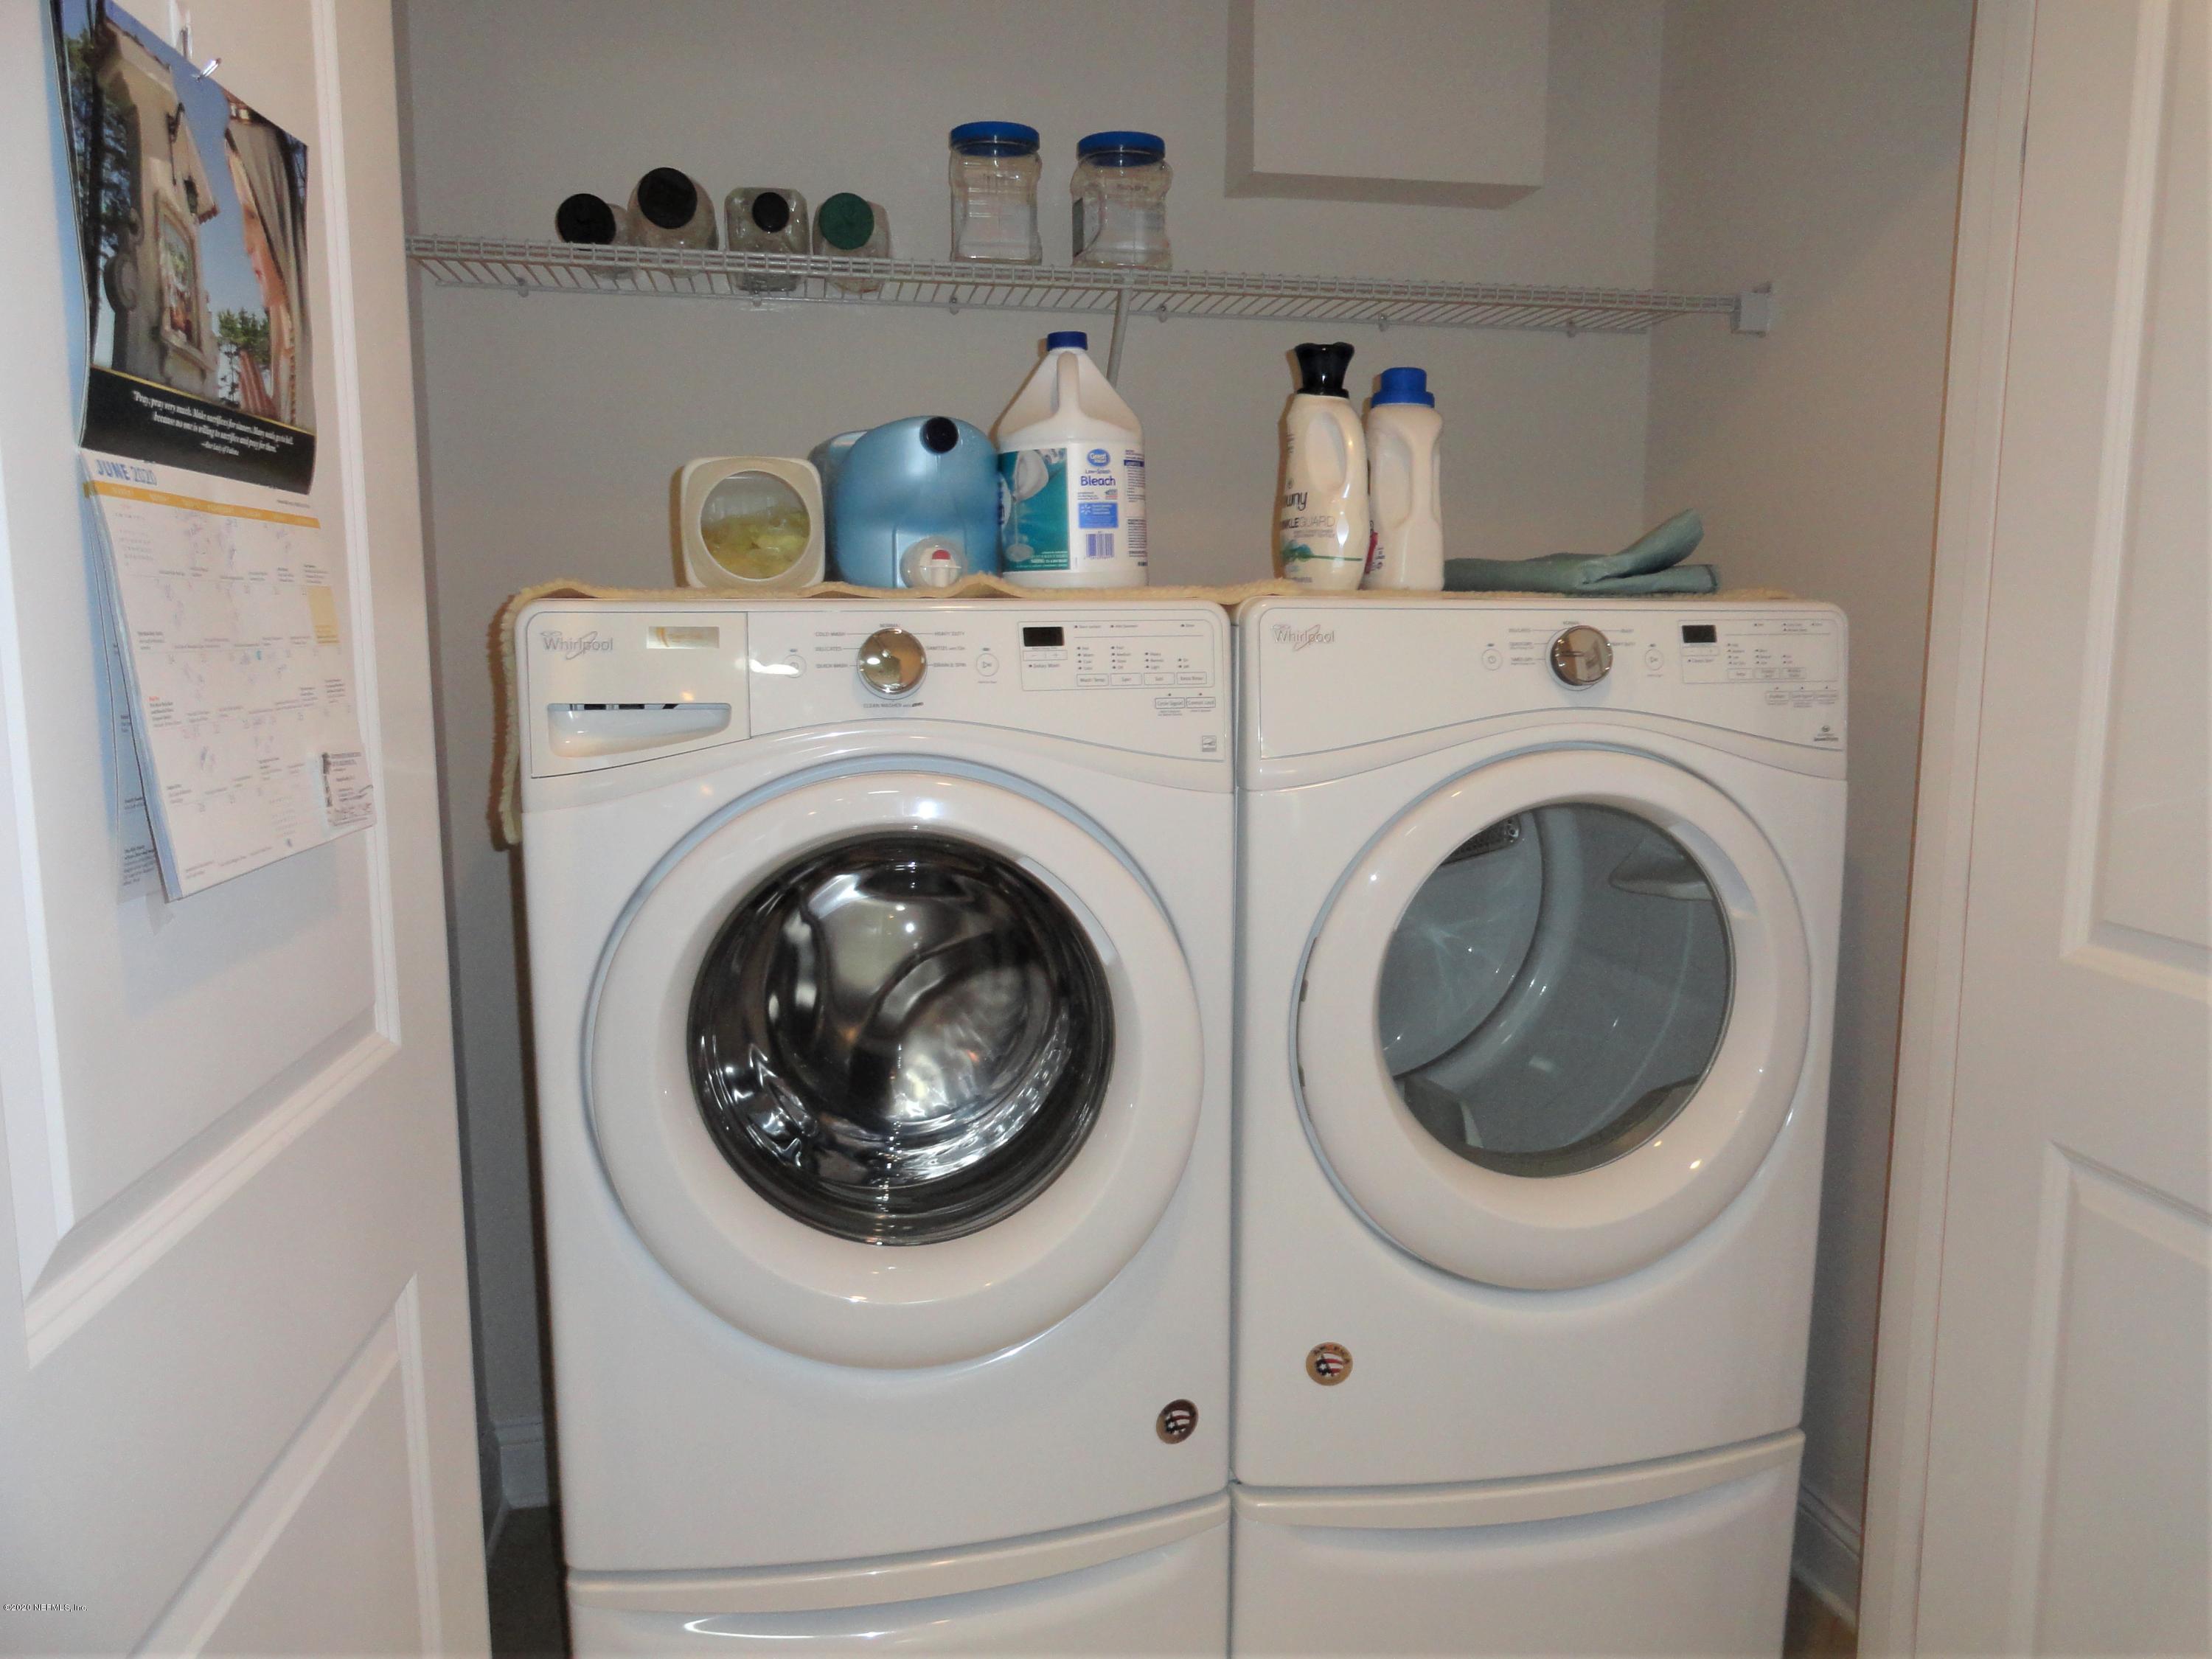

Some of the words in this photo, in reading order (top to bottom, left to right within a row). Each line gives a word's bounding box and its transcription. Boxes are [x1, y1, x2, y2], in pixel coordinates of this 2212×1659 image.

[94, 459, 131, 481] JUNE
[131, 465, 158, 486] 2020
[1080, 475, 1116, 487] Bleach
[541, 631, 613, 660] Whirlpool
[1270, 625, 1335, 652] Whirlpool
